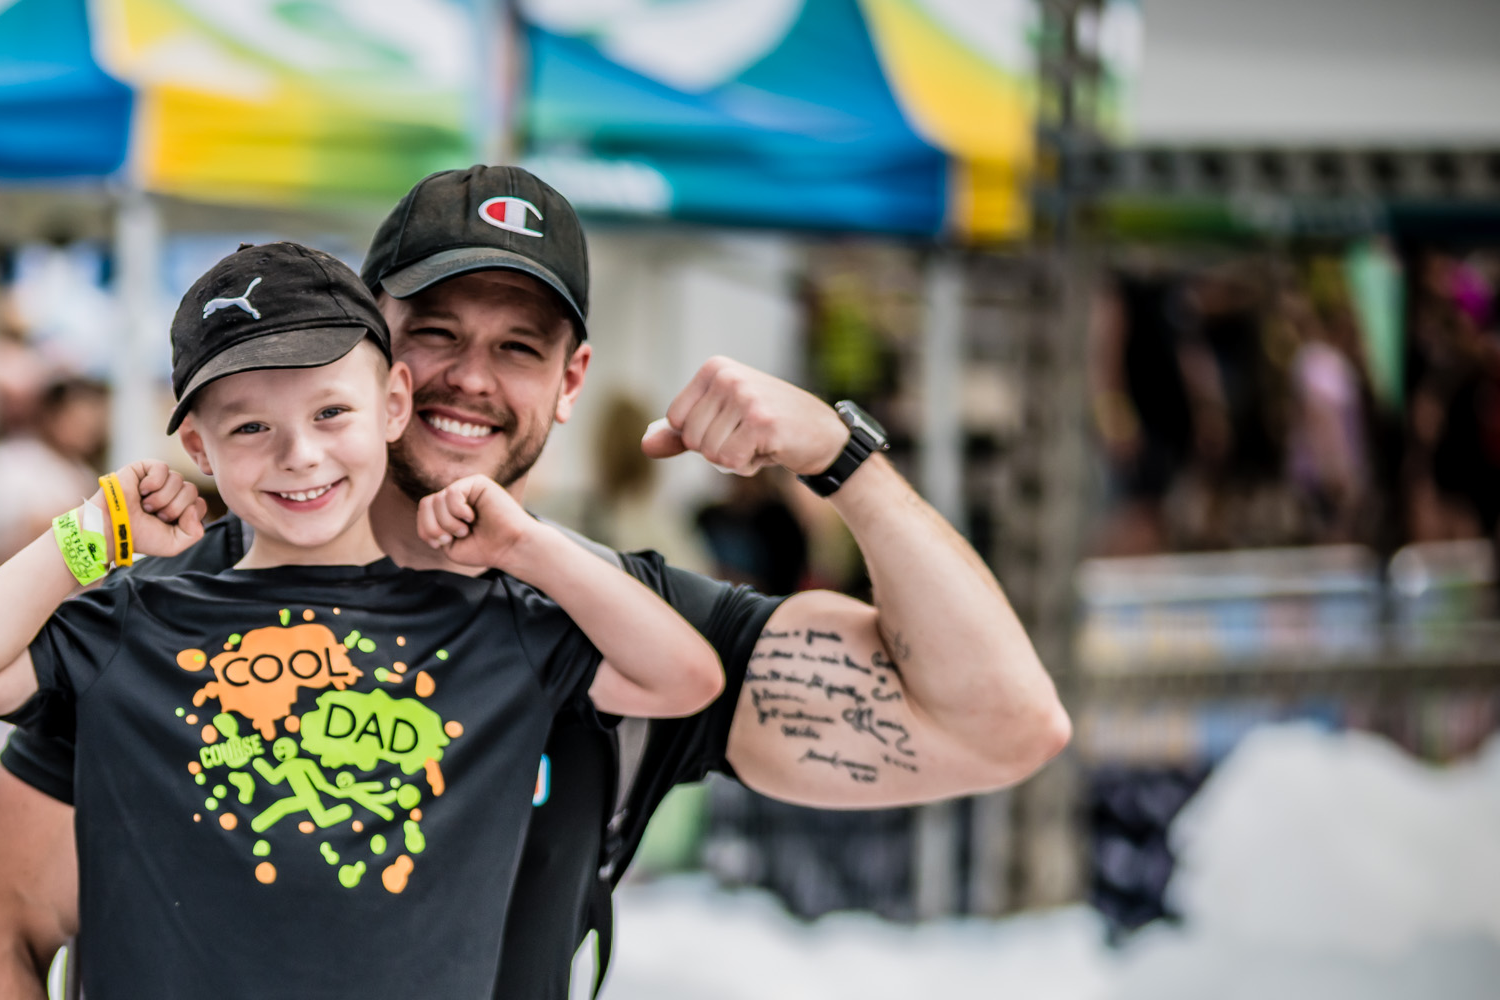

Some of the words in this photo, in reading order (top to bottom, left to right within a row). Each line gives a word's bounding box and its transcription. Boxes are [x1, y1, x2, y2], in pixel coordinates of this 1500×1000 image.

[221, 646, 349, 687] COOL
[324, 702, 420, 754] DAD
[199, 733, 265, 769] COURSE
